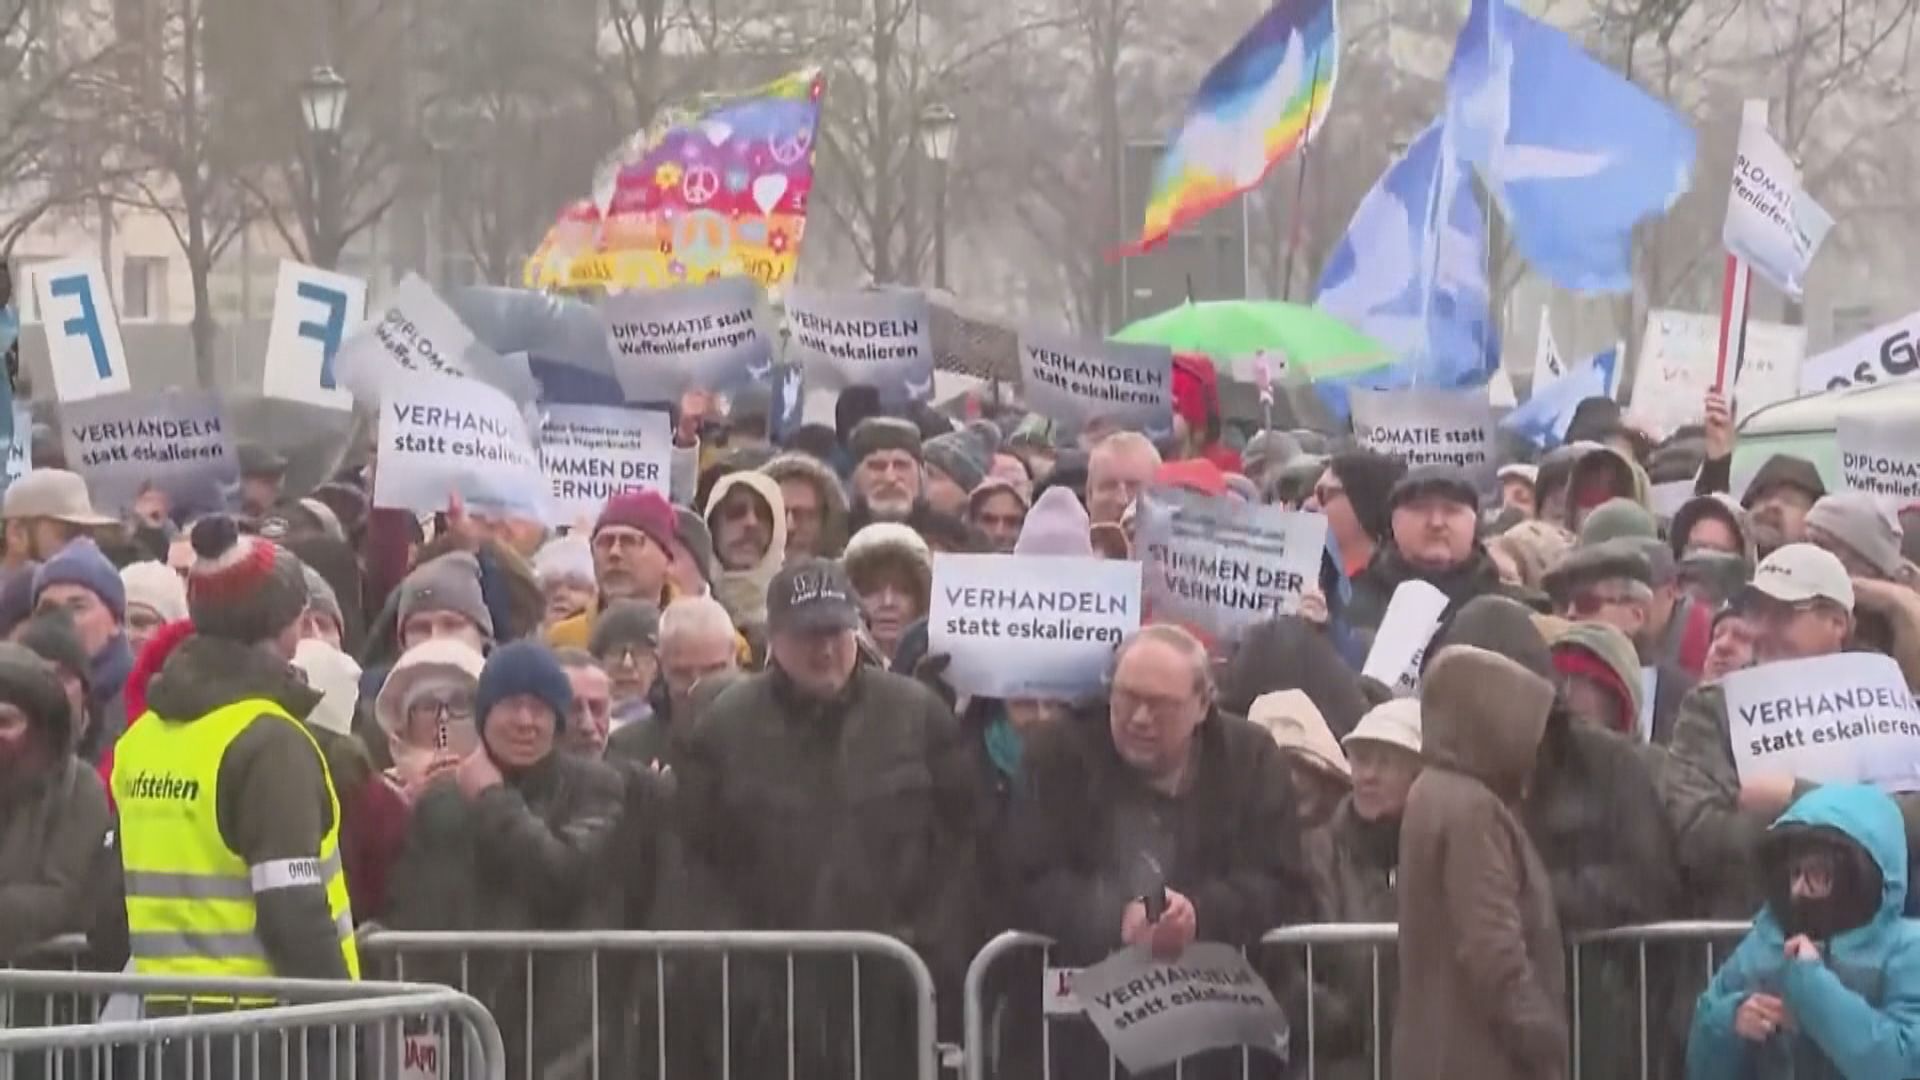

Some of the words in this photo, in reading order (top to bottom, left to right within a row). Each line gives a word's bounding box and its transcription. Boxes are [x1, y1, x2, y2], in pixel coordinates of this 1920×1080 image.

[612, 316, 713, 338] DIPLOMATIE
[717, 308, 753, 327] statt
[791, 309, 918, 338] VERHANDELN
[618, 328, 757, 355] Waffenlieferungen
[829, 341, 918, 360] eskalieren
[1027, 345, 1162, 387] VERHANDELN
[1071, 381, 1160, 404] eskalieren
[72, 417, 221, 443] VERHANDELN
[395, 433, 445, 453] statt
[1445, 428, 1485, 444] statt
[620, 461, 659, 480] DER
[1256, 566, 1303, 592] DER
[945, 586, 1128, 616] VERHANDELN
[947, 617, 1000, 636] statt
[1007, 619, 1124, 644] eskalieren
[1750, 727, 1805, 756] statt
[1114, 997, 1168, 1030] statt
